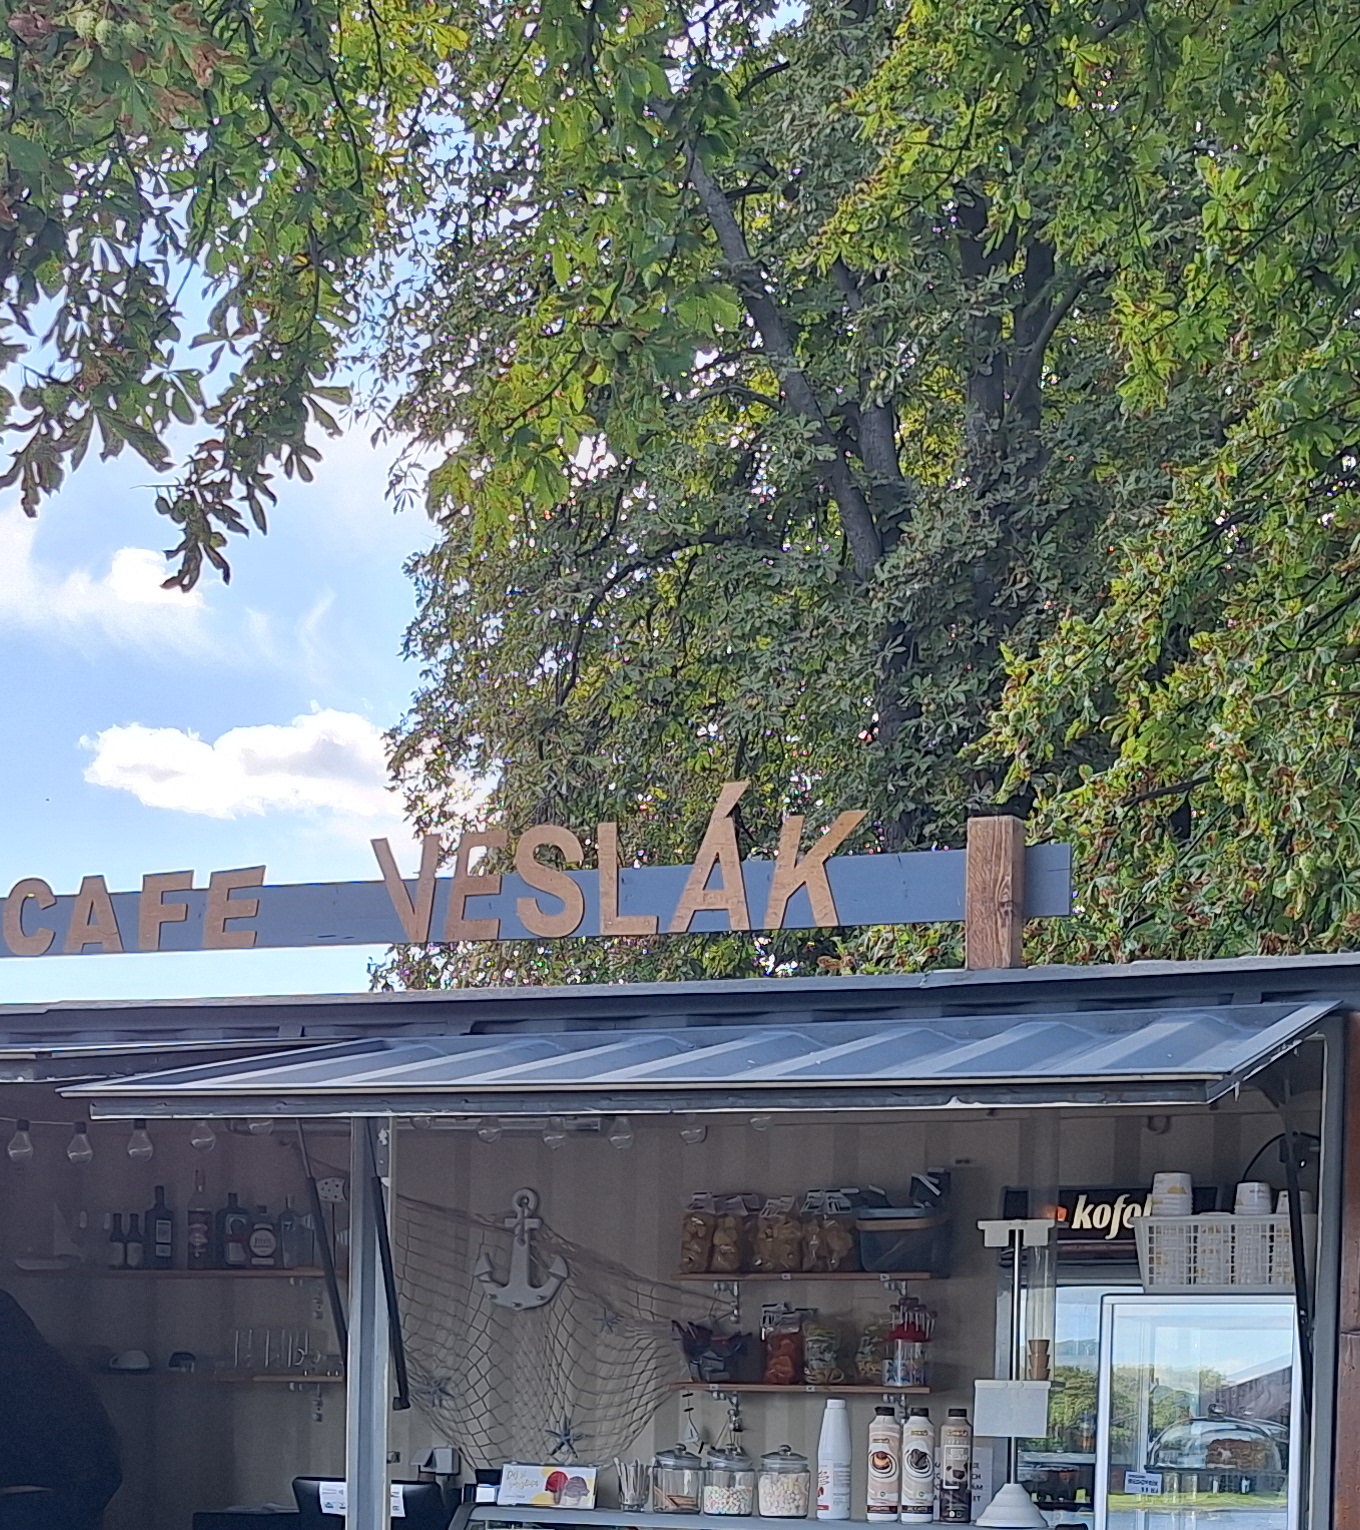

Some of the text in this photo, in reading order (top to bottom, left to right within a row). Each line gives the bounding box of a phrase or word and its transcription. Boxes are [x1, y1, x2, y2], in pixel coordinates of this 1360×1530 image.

[2, 780, 868, 957] CAFE VESLÁK
[1071, 1193, 1153, 1240] kofol
